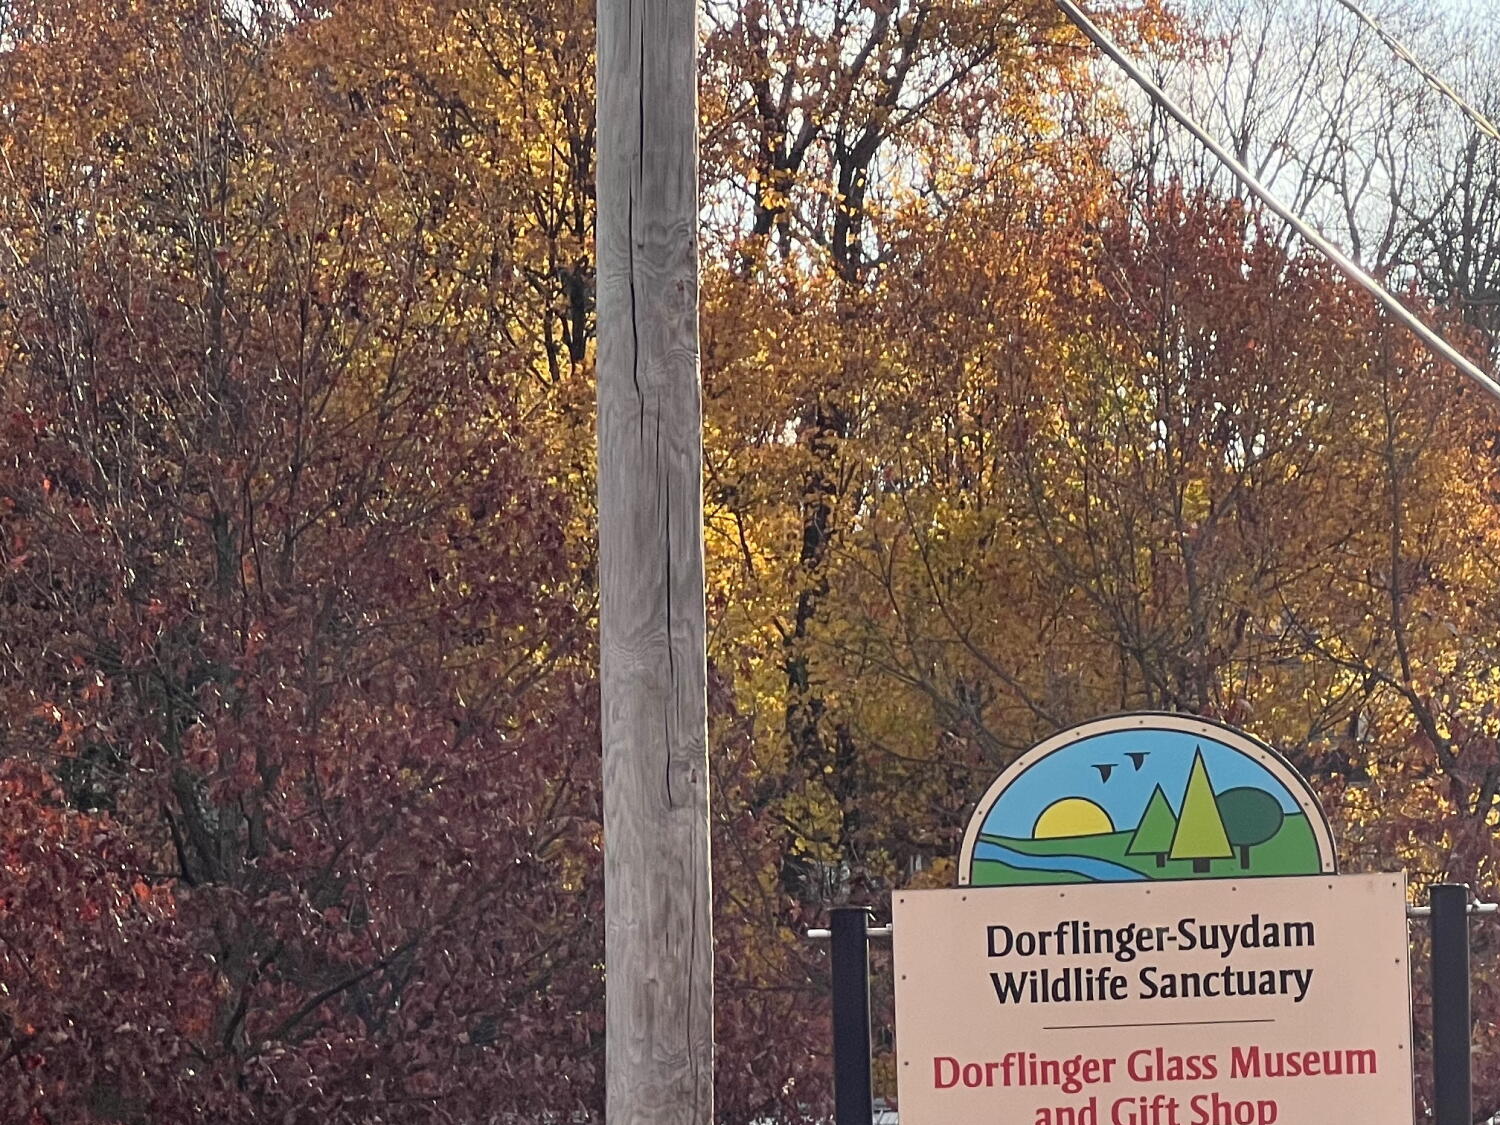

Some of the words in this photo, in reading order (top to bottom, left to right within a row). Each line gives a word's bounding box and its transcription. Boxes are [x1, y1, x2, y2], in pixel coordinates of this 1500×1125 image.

[987, 914, 1315, 961] Dorflinger-Suydam
[990, 968, 1128, 1004] Wildlife
[1139, 966, 1313, 1002] Sanctuary
[933, 1052, 1116, 1093] Dorflinger
[1128, 1047, 1217, 1082] Glass
[1230, 1045, 1377, 1079] Museum
